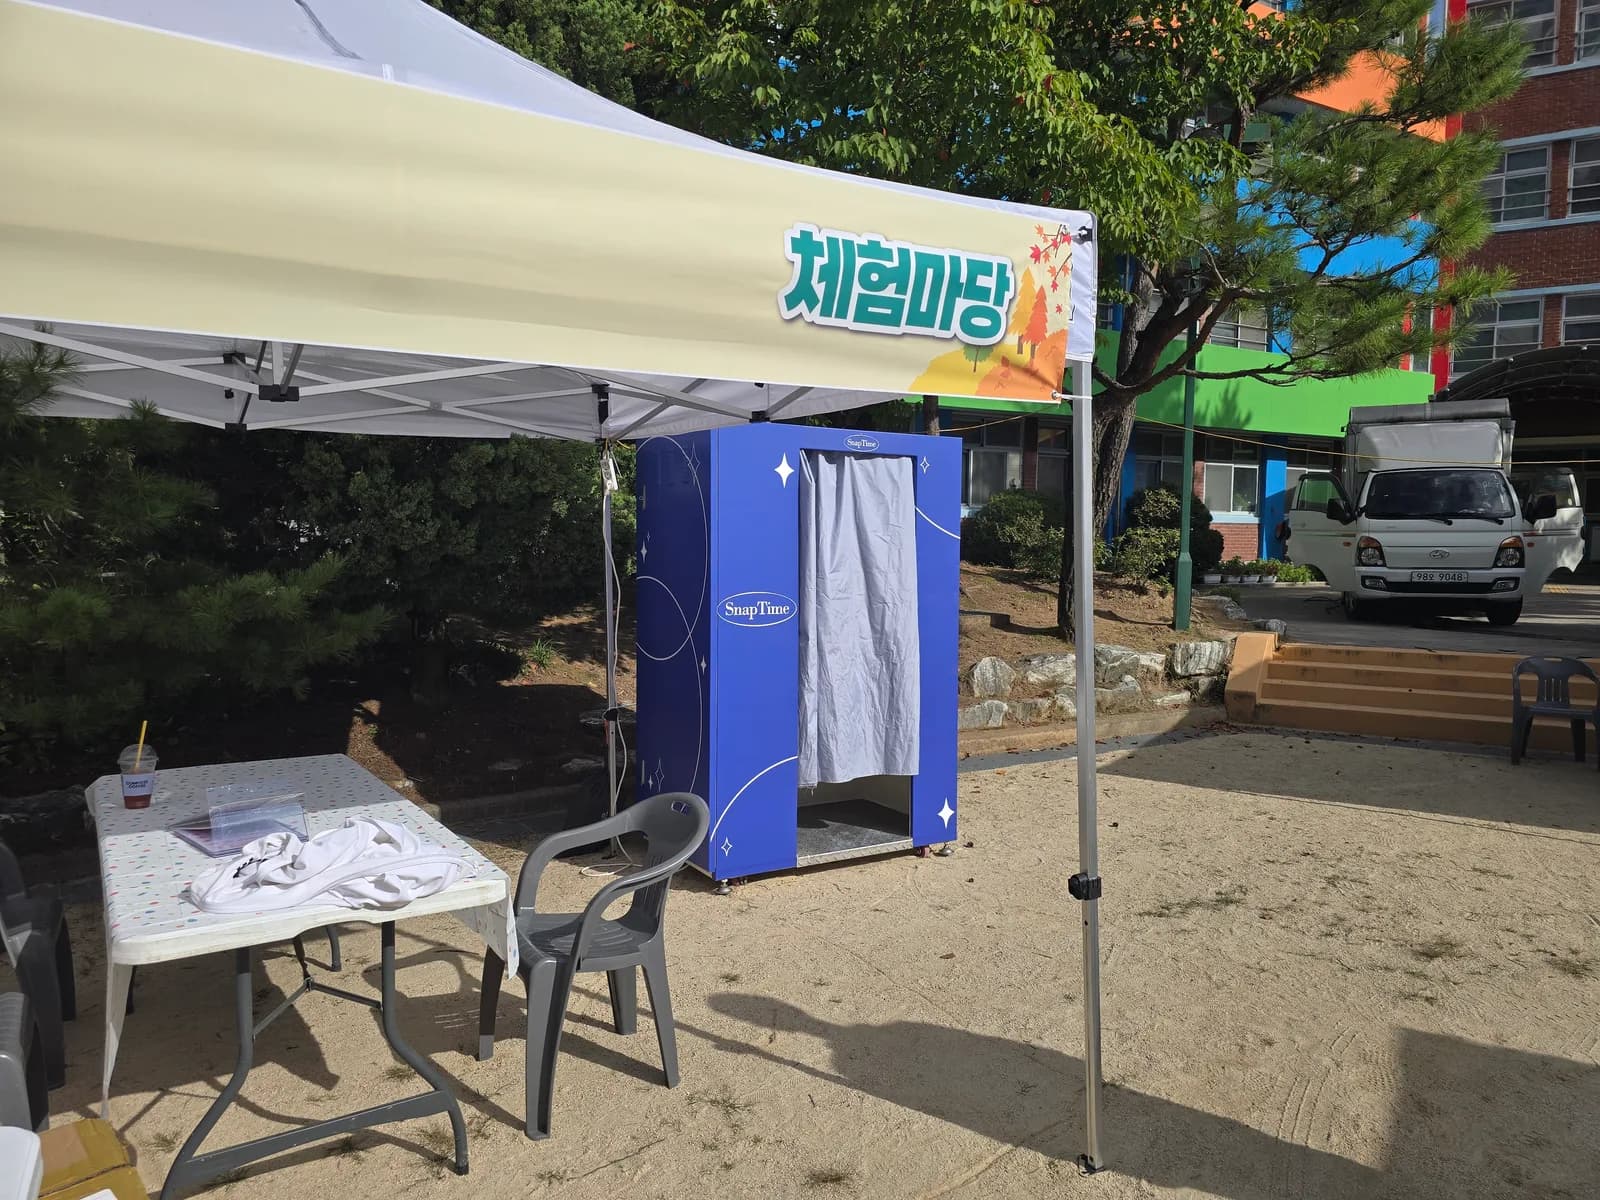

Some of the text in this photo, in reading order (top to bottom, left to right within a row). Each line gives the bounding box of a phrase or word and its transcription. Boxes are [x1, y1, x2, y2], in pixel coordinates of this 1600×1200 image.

[783, 228, 1011, 339] 체험마당
[846, 438, 877, 449] SnapTime
[725, 601, 790, 620] SnapTime
